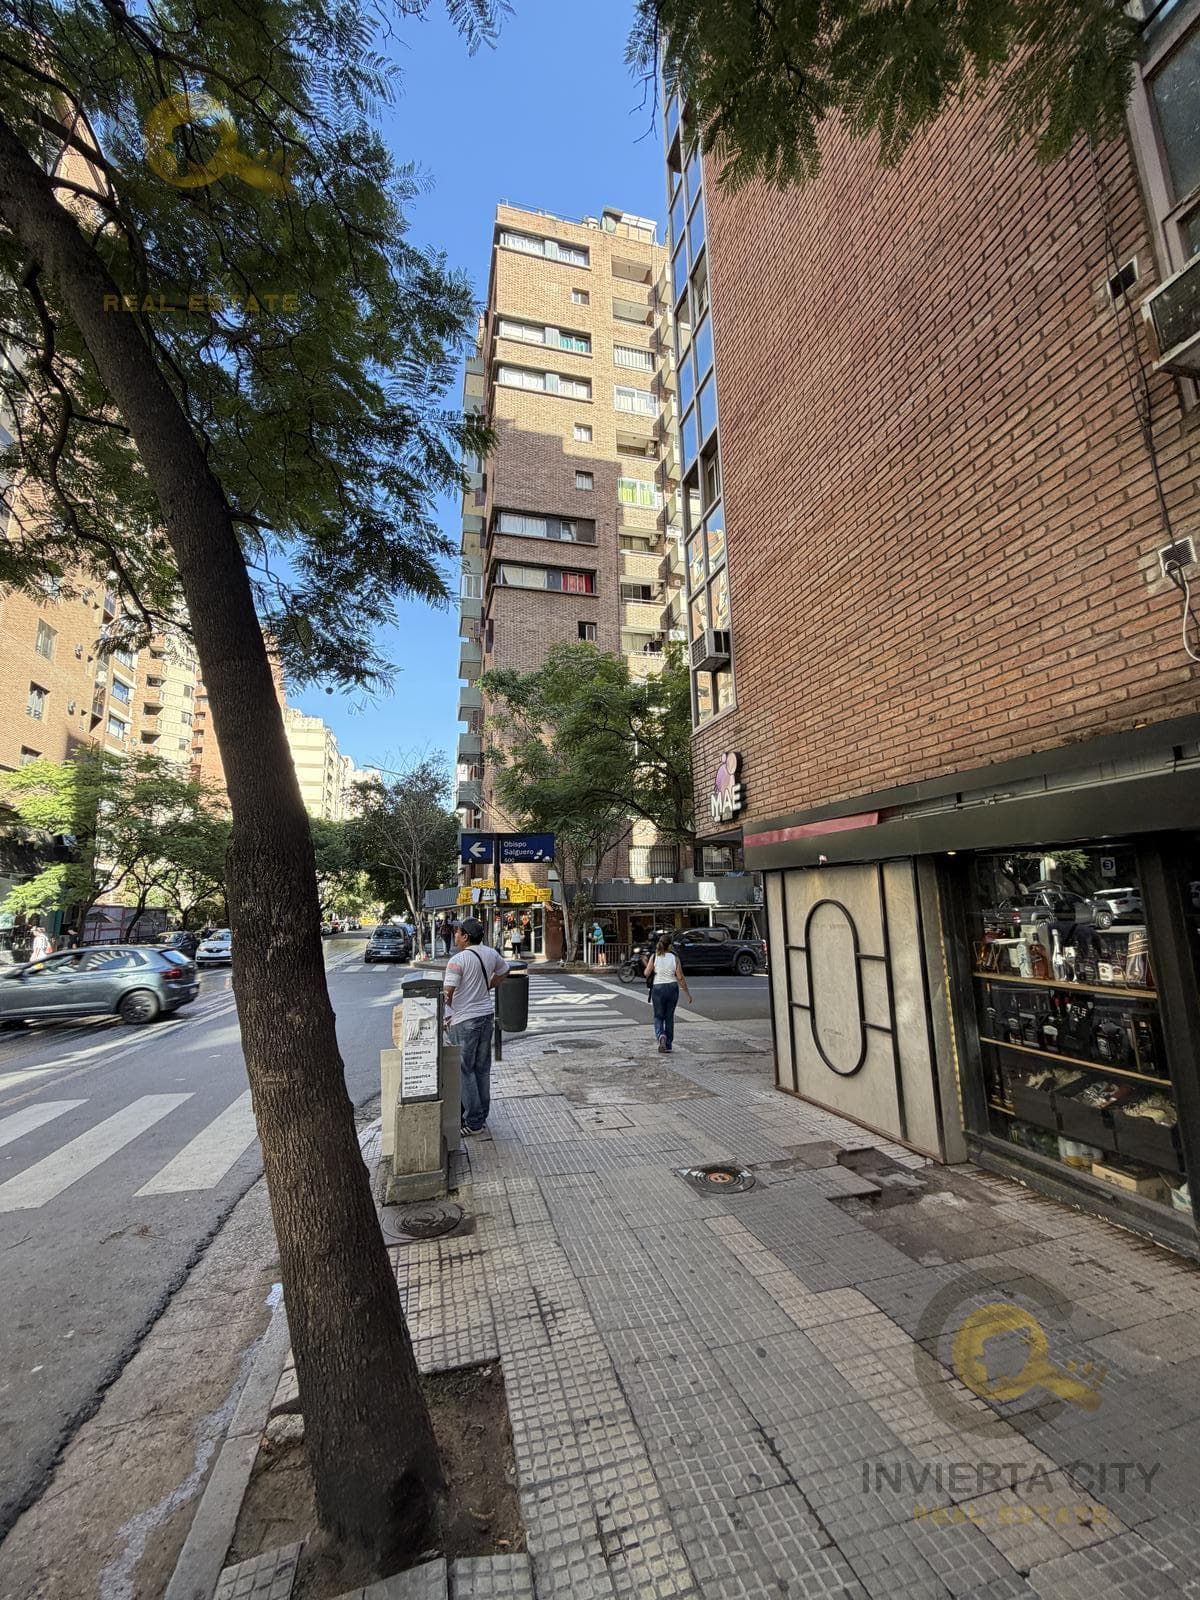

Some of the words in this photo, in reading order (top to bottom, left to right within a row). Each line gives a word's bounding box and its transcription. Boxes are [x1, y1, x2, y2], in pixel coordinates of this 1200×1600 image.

[711, 784, 741, 817] MAE
[503, 841, 527, 849] Obispo
[503, 848, 534, 857] Salguero
